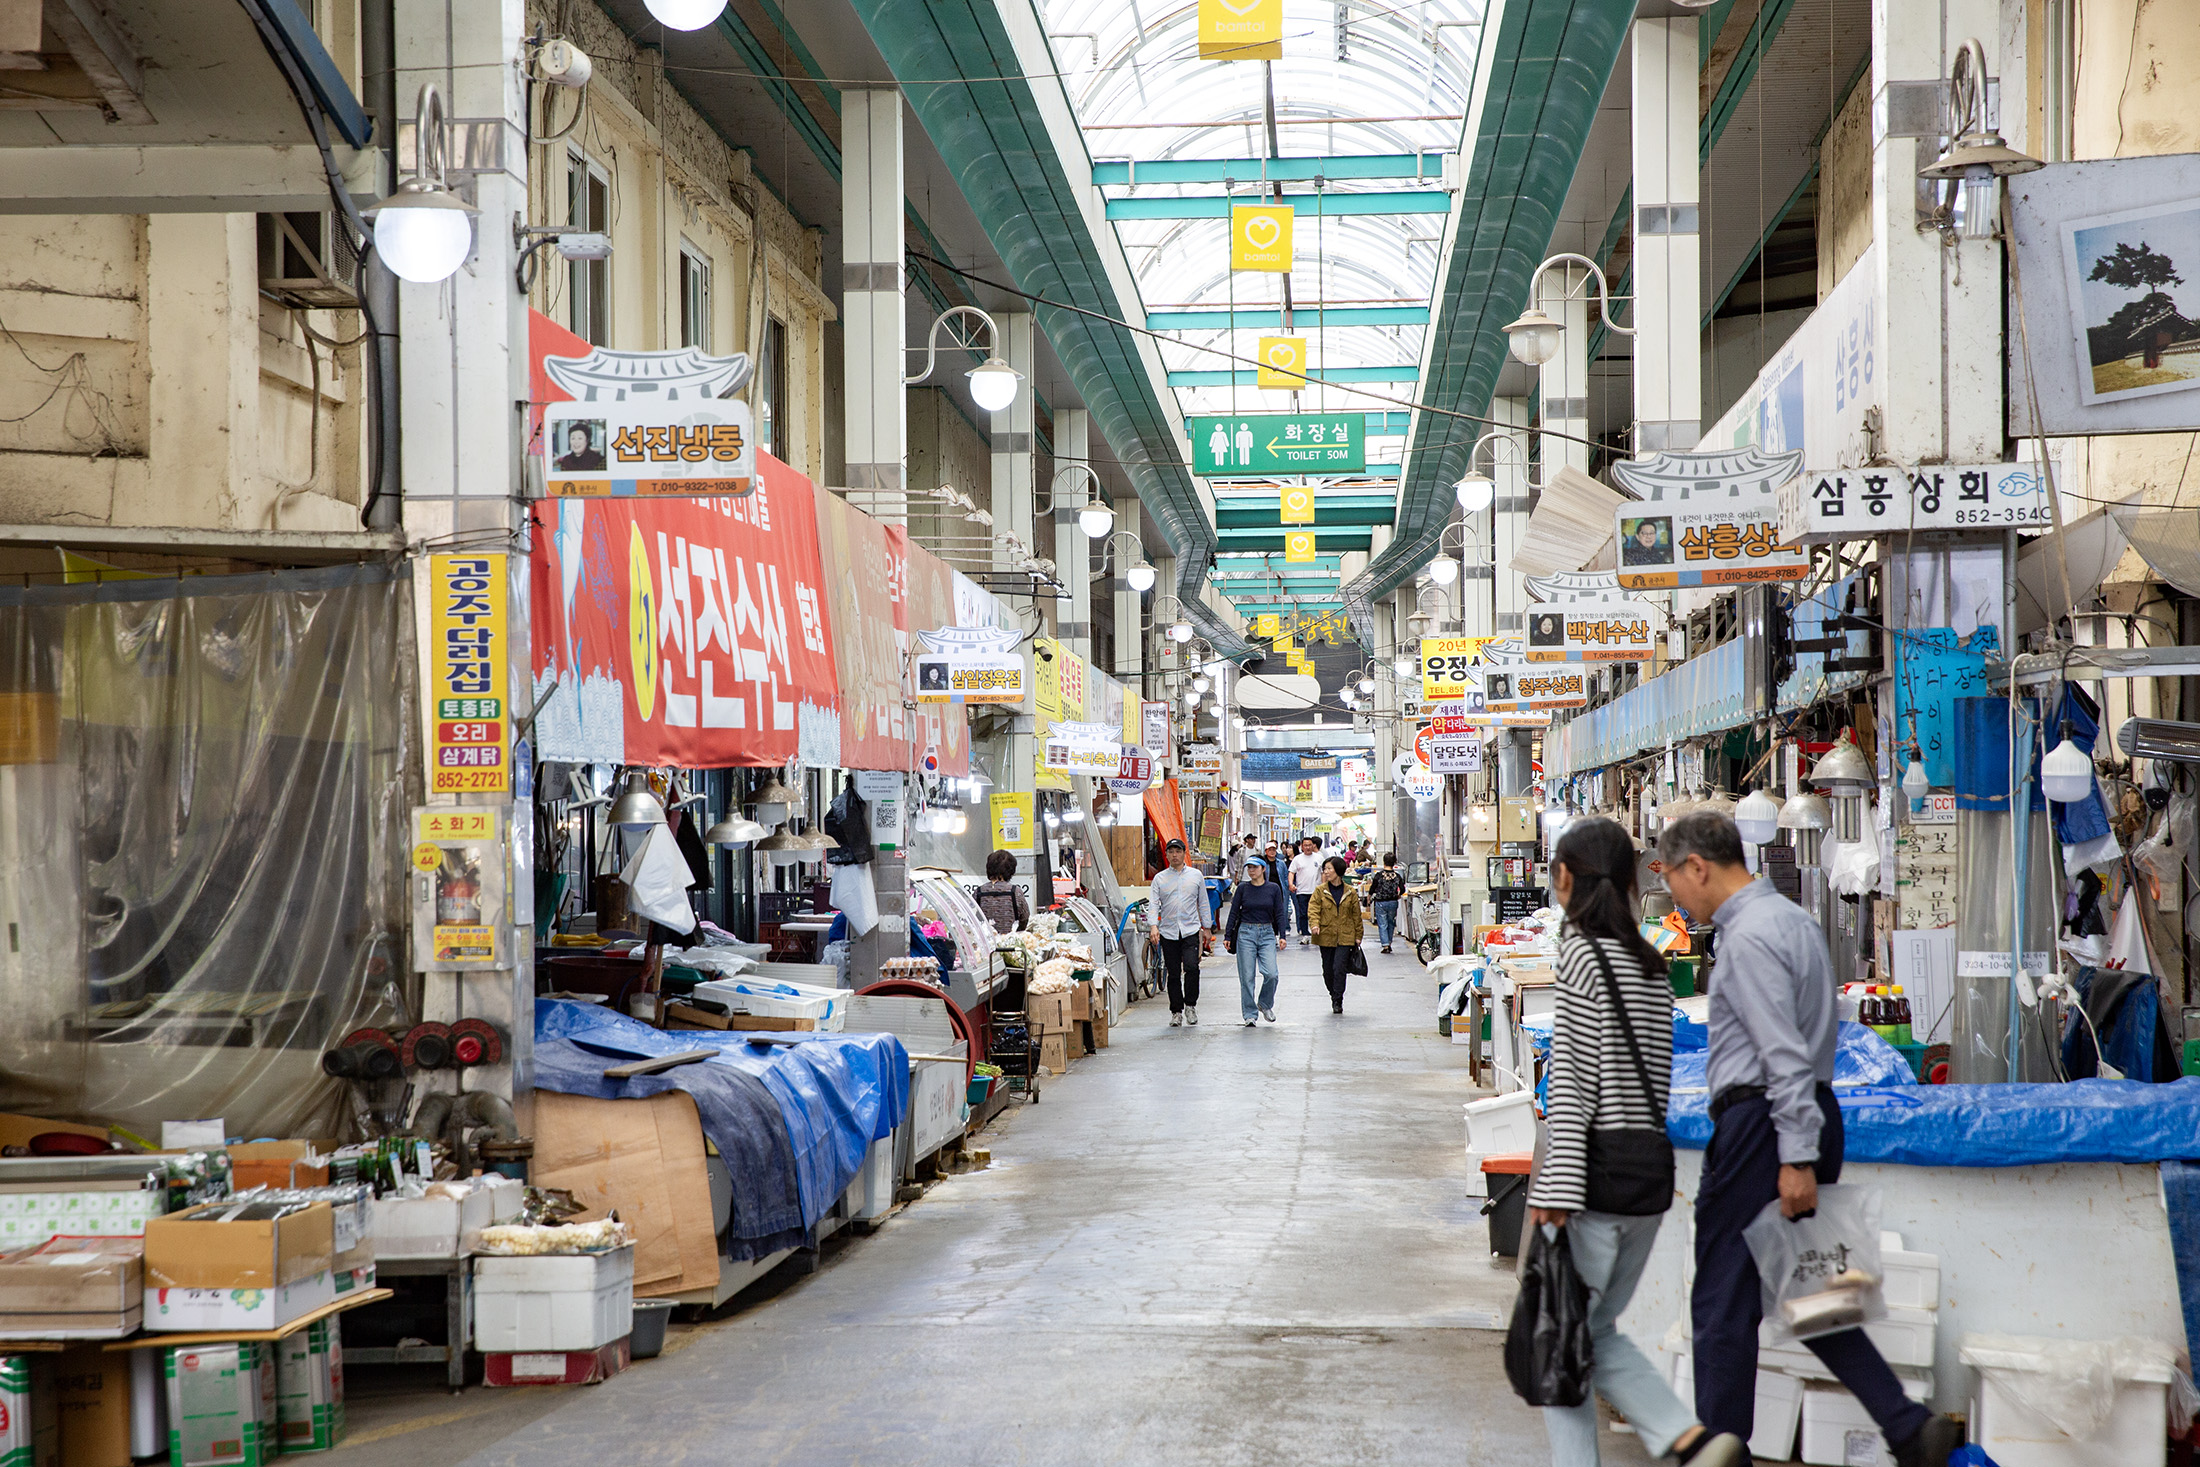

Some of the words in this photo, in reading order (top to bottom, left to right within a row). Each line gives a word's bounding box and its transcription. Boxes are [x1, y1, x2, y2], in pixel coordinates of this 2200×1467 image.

[1215, 21, 1265, 33] bamtol
[1244, 252, 1280, 262] bamtol
[1285, 423, 1349, 443] 화장실
[611, 425, 744, 463] 선진냉동
[1287, 451, 1321, 461] TOILET
[1327, 450, 1348, 460] 50M
[651, 481, 738, 493] T.010-9322-1038
[1812, 470, 1990, 517] 삼흥상회
[1715, 569, 1798, 582] T.010-8425-8785
[445, 559, 495, 693] 공주닭집
[656, 530, 795, 732] 선진수산
[1566, 620, 1650, 645] 백제수산
[1438, 641, 1467, 652] 20년
[1593, 652, 1644, 660] T.041-855-6756
[951, 668, 1022, 690] 삼일정육점
[1518, 675, 1584, 698] 청주상회
[1429, 685, 1465, 694] TEL.855
[443, 699, 497, 718] 토종닭
[452, 723, 488, 742] 오리
[442, 748, 498, 766] 삼계닭
[1434, 745, 1478, 759] 달달도넛
[1070, 752, 1120, 768] 누리축산
[1121, 758, 1150, 779] 어물
[436, 772, 503, 788] 852-2721
[1110, 780, 1141, 790] 852-4962
[1413, 785, 1435, 797] 식당
[1933, 797, 1956, 811] CCT
[429, 816, 485, 831] 소화기
[420, 856, 435, 865] 44
